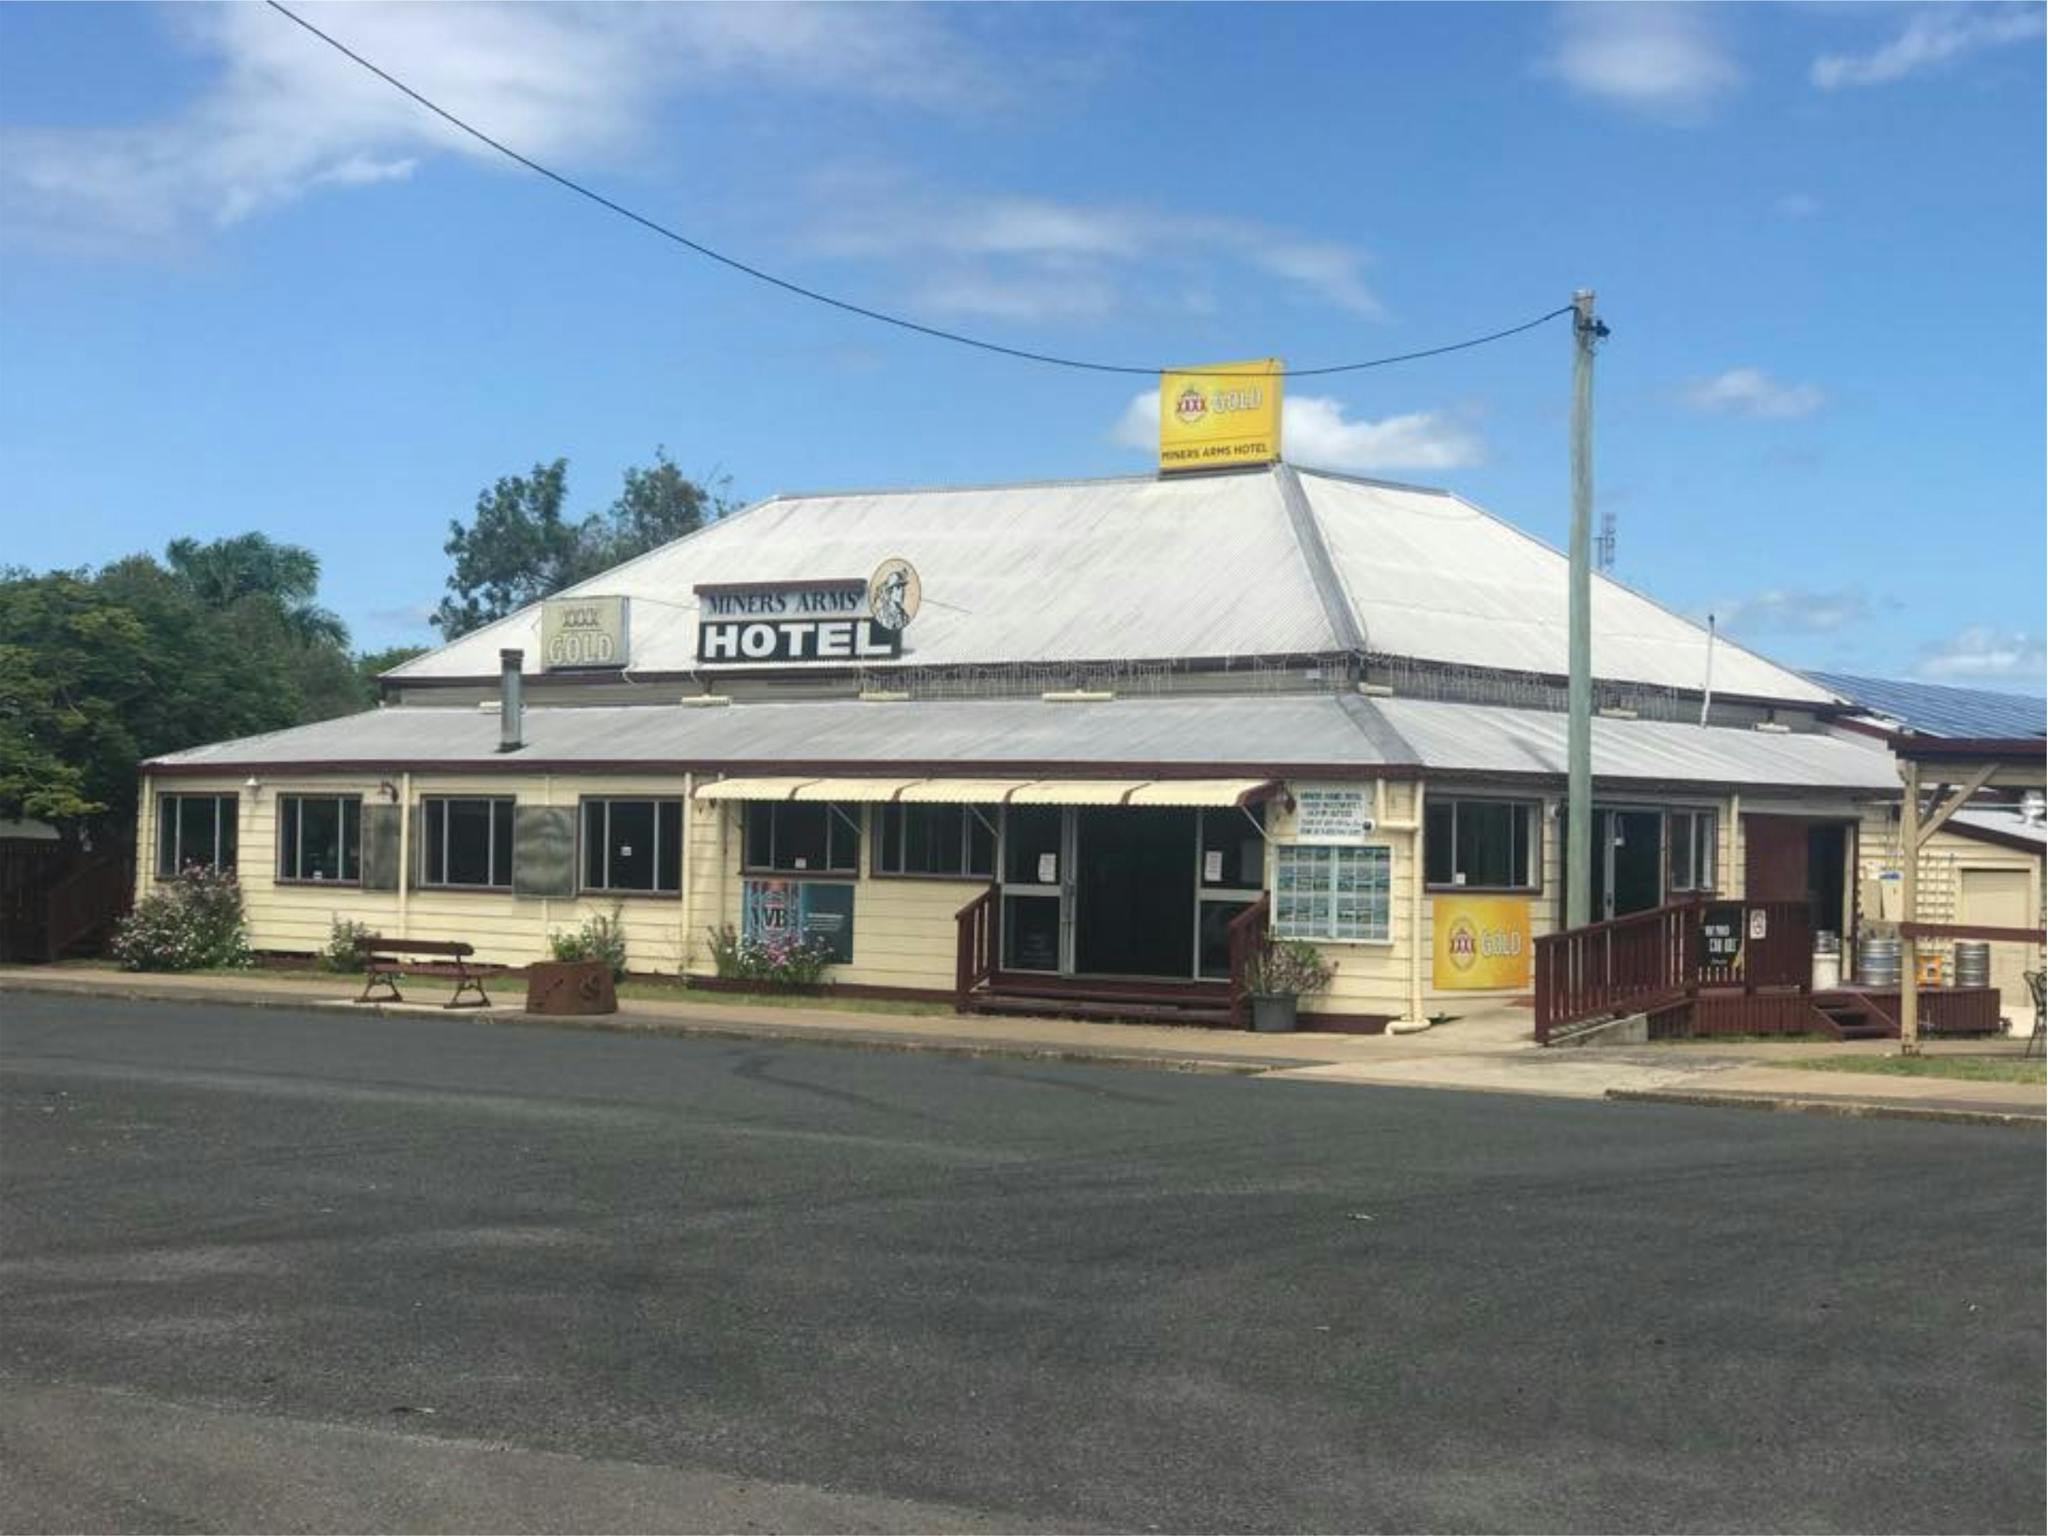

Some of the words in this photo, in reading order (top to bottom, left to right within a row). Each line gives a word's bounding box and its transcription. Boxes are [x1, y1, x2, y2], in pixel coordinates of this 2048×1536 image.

[1213, 389, 1263, 414] GOLD
[1161, 449, 1200, 460] MINERS
[1202, 446, 1231, 458] ARMS
[1234, 443, 1268, 456] HOTEL
[707, 592, 787, 615] MINERS
[794, 590, 858, 612] ARMS
[549, 633, 615, 663] GOLD
[704, 622, 892, 658] HOTEL
[1481, 929, 1521, 957] GOLD
